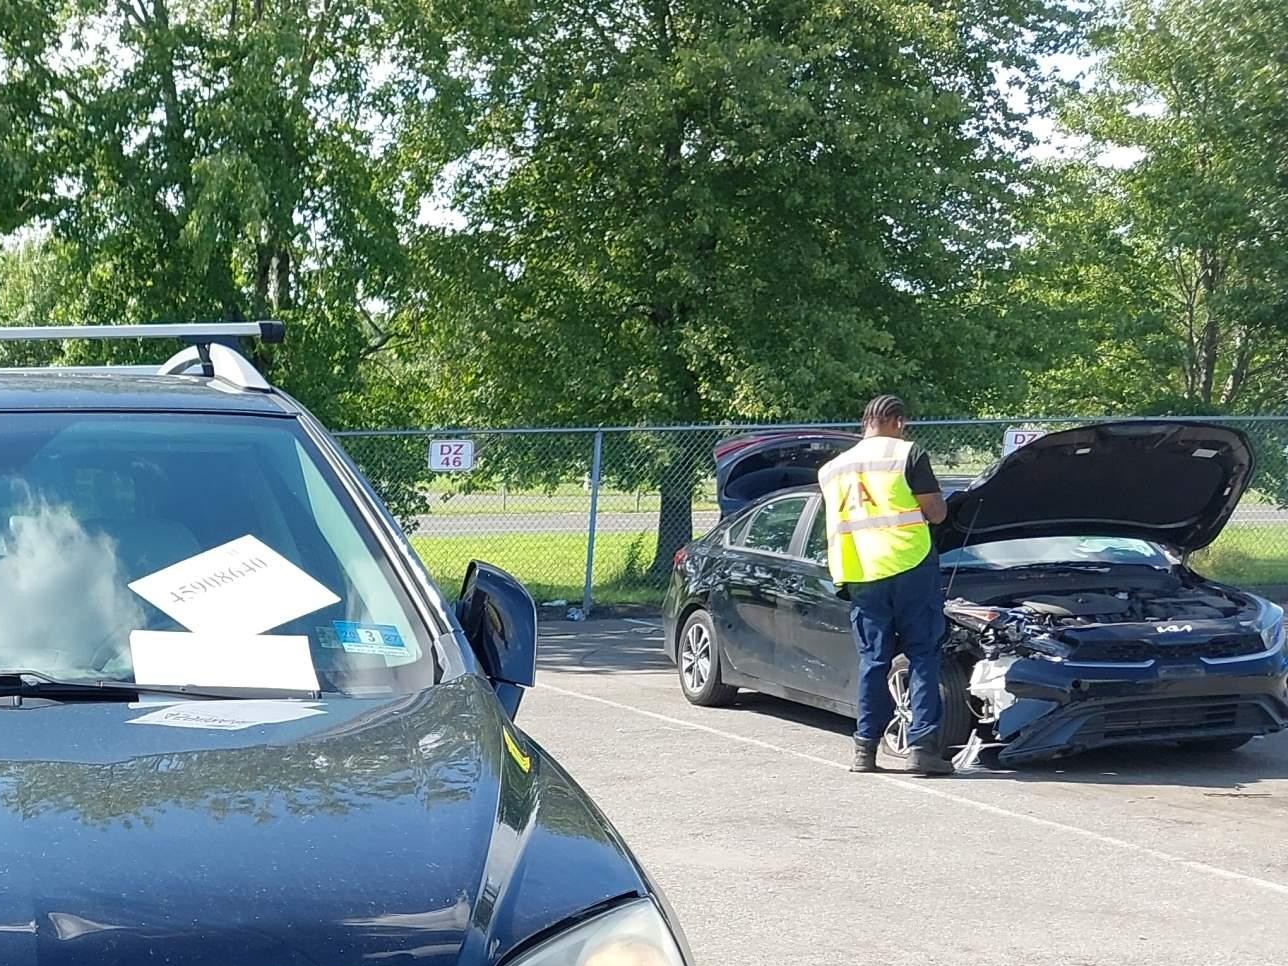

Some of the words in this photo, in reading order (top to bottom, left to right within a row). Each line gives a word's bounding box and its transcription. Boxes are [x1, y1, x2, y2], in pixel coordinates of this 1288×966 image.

[1014, 433, 1038, 445] DZ
[440, 444, 464, 456] DZ
[440, 456, 462, 467] 46
[170, 557, 268, 603] 45908640
[364, 630, 376, 642] 3
